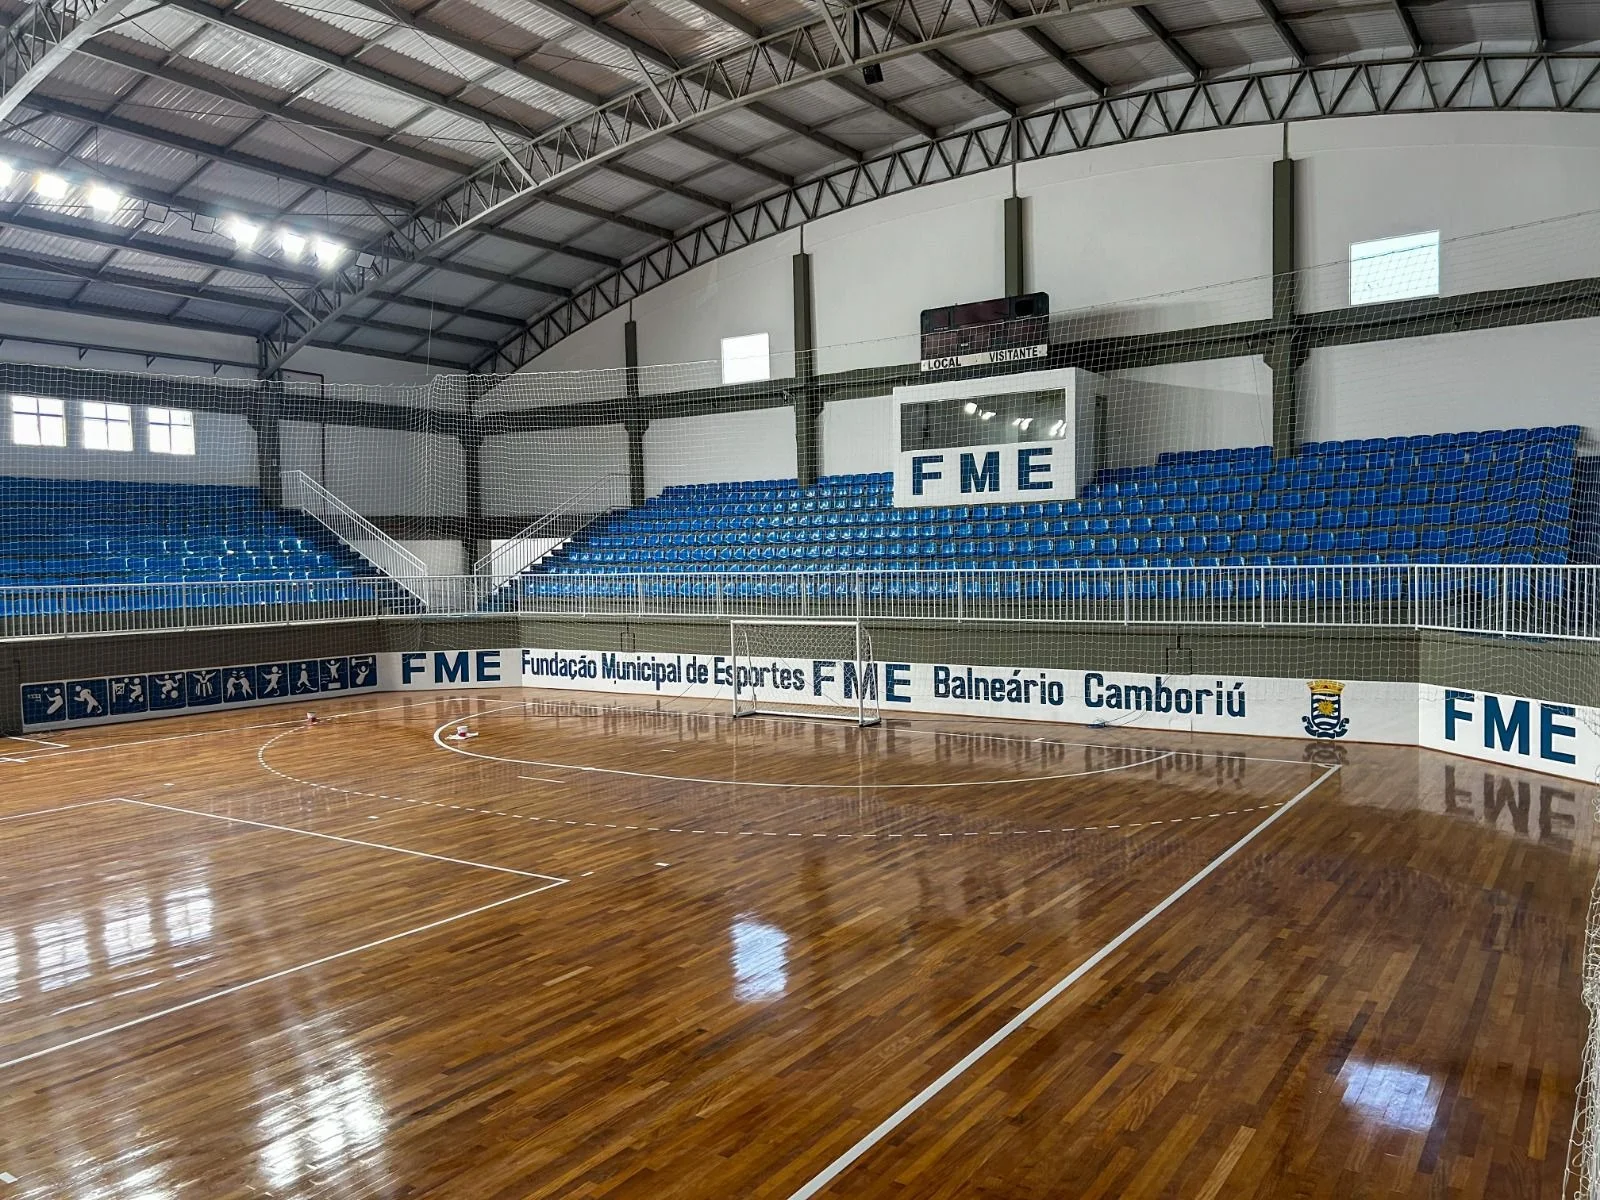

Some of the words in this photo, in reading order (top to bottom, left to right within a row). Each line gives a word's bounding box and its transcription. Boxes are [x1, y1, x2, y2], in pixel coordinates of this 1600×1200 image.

[928, 356, 961, 370] LOCAL
[989, 346, 1038, 363] VISITANTE
[912, 447, 1053, 496] FME
[401, 650, 501, 685] FME
[521, 649, 597, 681] Fundação
[601, 652, 681, 691] Municipal
[686, 655, 709, 685] de
[713, 656, 805, 695] Esportes
[812, 660, 912, 703] FME
[933, 665, 1065, 707] Balneário
[1084, 672, 1247, 718] Camboriú
[1444, 689, 1576, 765] FME
